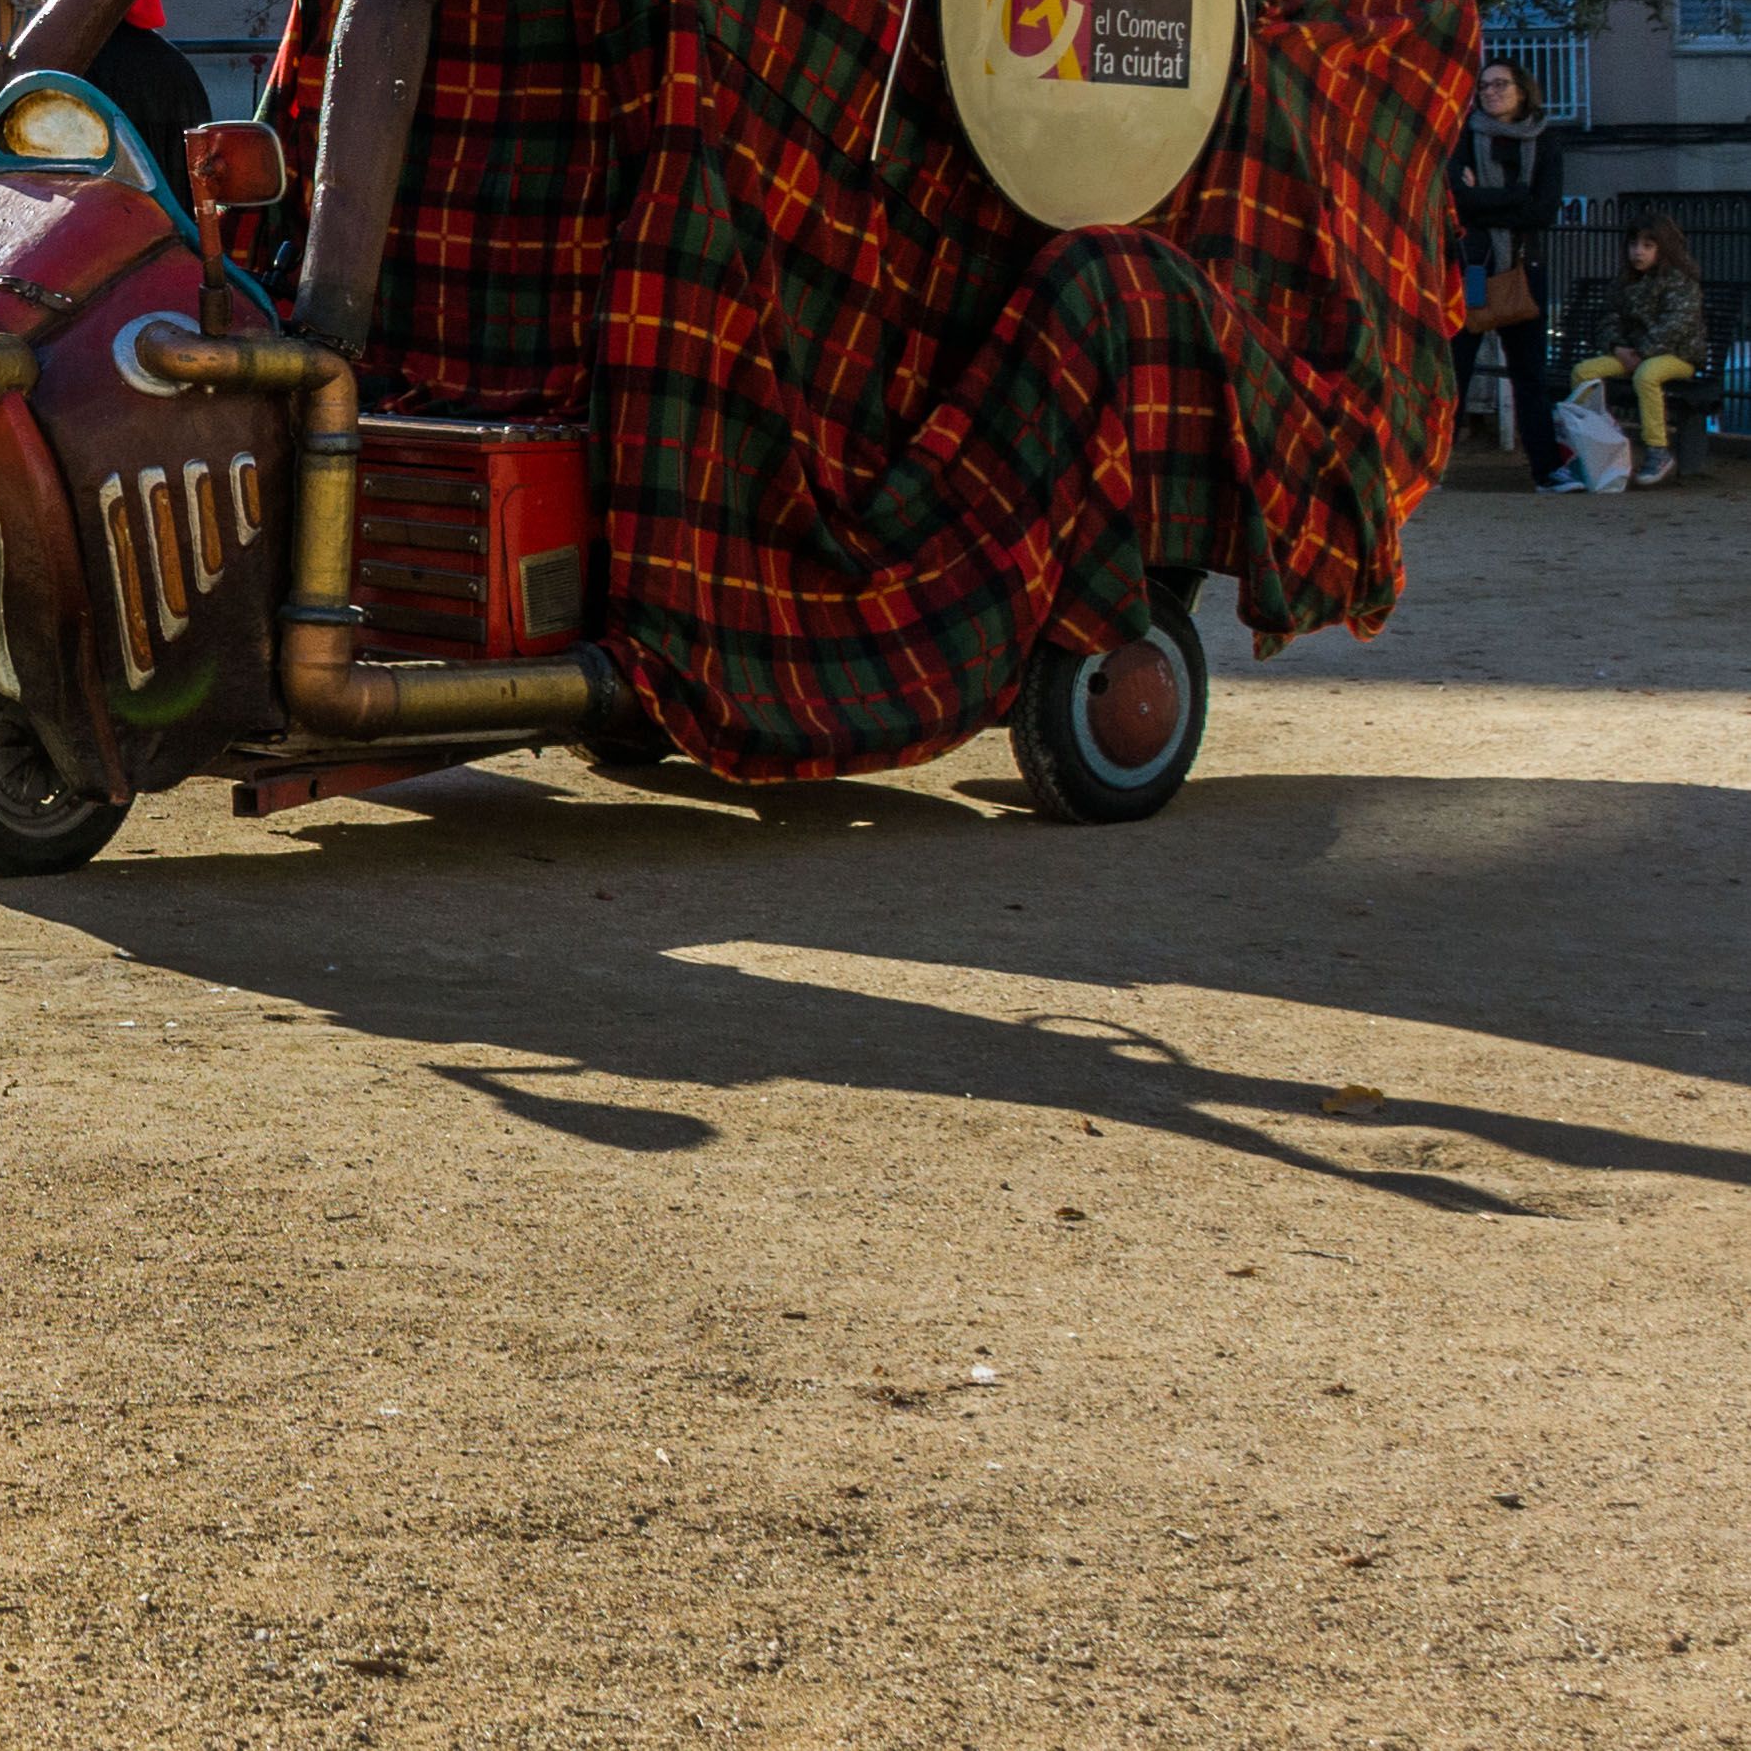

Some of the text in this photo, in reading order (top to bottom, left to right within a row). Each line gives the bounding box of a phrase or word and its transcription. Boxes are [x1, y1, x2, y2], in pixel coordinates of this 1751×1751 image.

[1095, 8, 1185, 49] el Comerç
[1094, 43, 1184, 80] fa ciutat
